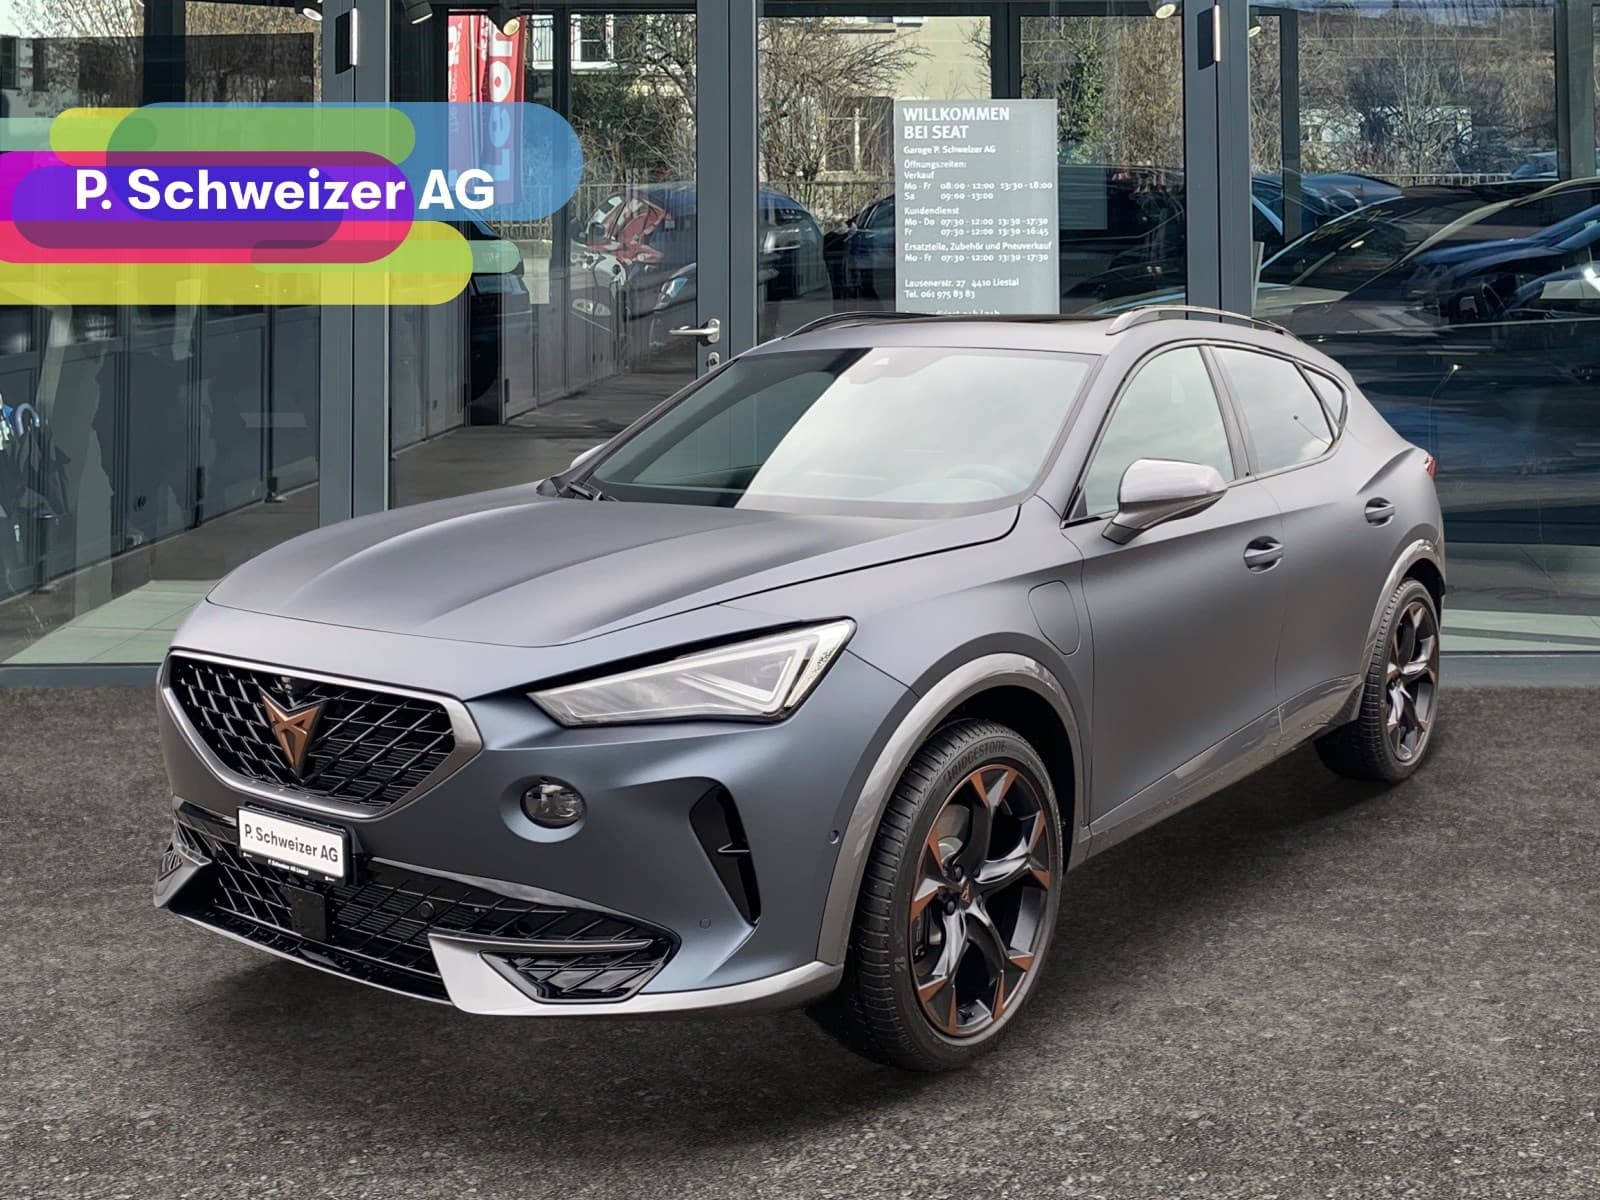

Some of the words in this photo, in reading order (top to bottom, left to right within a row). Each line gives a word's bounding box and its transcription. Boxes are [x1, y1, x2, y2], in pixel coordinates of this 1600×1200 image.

[903, 107, 1010, 121] WILLKOMMEN
[904, 126, 928, 139] BEI
[932, 125, 969, 139] SEAT
[903, 146, 932, 155] Garage
[933, 146, 941, 154] P.
[942, 145, 983, 154] Schweizer
[983, 145, 996, 154] AG
[904, 159, 967, 169] Öffnungszeiten:
[904, 171, 935, 179] Verkauf
[904, 182, 917, 190] Mo
[923, 182, 931, 190] Fr
[940, 182, 965, 190] 08:00
[972, 182, 995, 190] 12:00
[1000, 182, 1023, 190] 13:30
[1029, 181, 1053, 189] 18:00
[971, 193, 994, 201] 13:00
[904, 207, 960, 215] Kundendienst
[924, 218, 935, 226] Do
[940, 219, 965, 227] 07:30
[1026, 218, 1049, 226] 17:30
[940, 229, 965, 237] 07:30
[998, 229, 1021, 237] 13:30
[1026, 228, 1049, 236] 16:45
[904, 243, 949, 252] Ersatzteile,
[950, 242, 984, 250] Zubehör
[985, 242, 1000, 250] und
[1002, 242, 1053, 250] Pneuverkauf
[904, 254, 917, 262] Mo
[924, 254, 932, 262] Fr
[941, 255, 965, 263] 07:30
[998, 254, 1021, 262] 13:30
[1027, 254, 1049, 262] 17:30
[904, 279, 954, 288] Lausenerstr.
[956, 280, 966, 288] 27
[971, 280, 992, 288] 4410
[993, 278, 1019, 286] Liestal
[904, 290, 920, 298] Tel.
[921, 290, 935, 298] 061
[936, 291, 951, 299] 975
[953, 290, 963, 299] 83
[965, 290, 976, 299] 83
[245, 824, 254, 839] P.
[256, 827, 317, 857] Schweizer
[320, 845, 338, 862] AG
